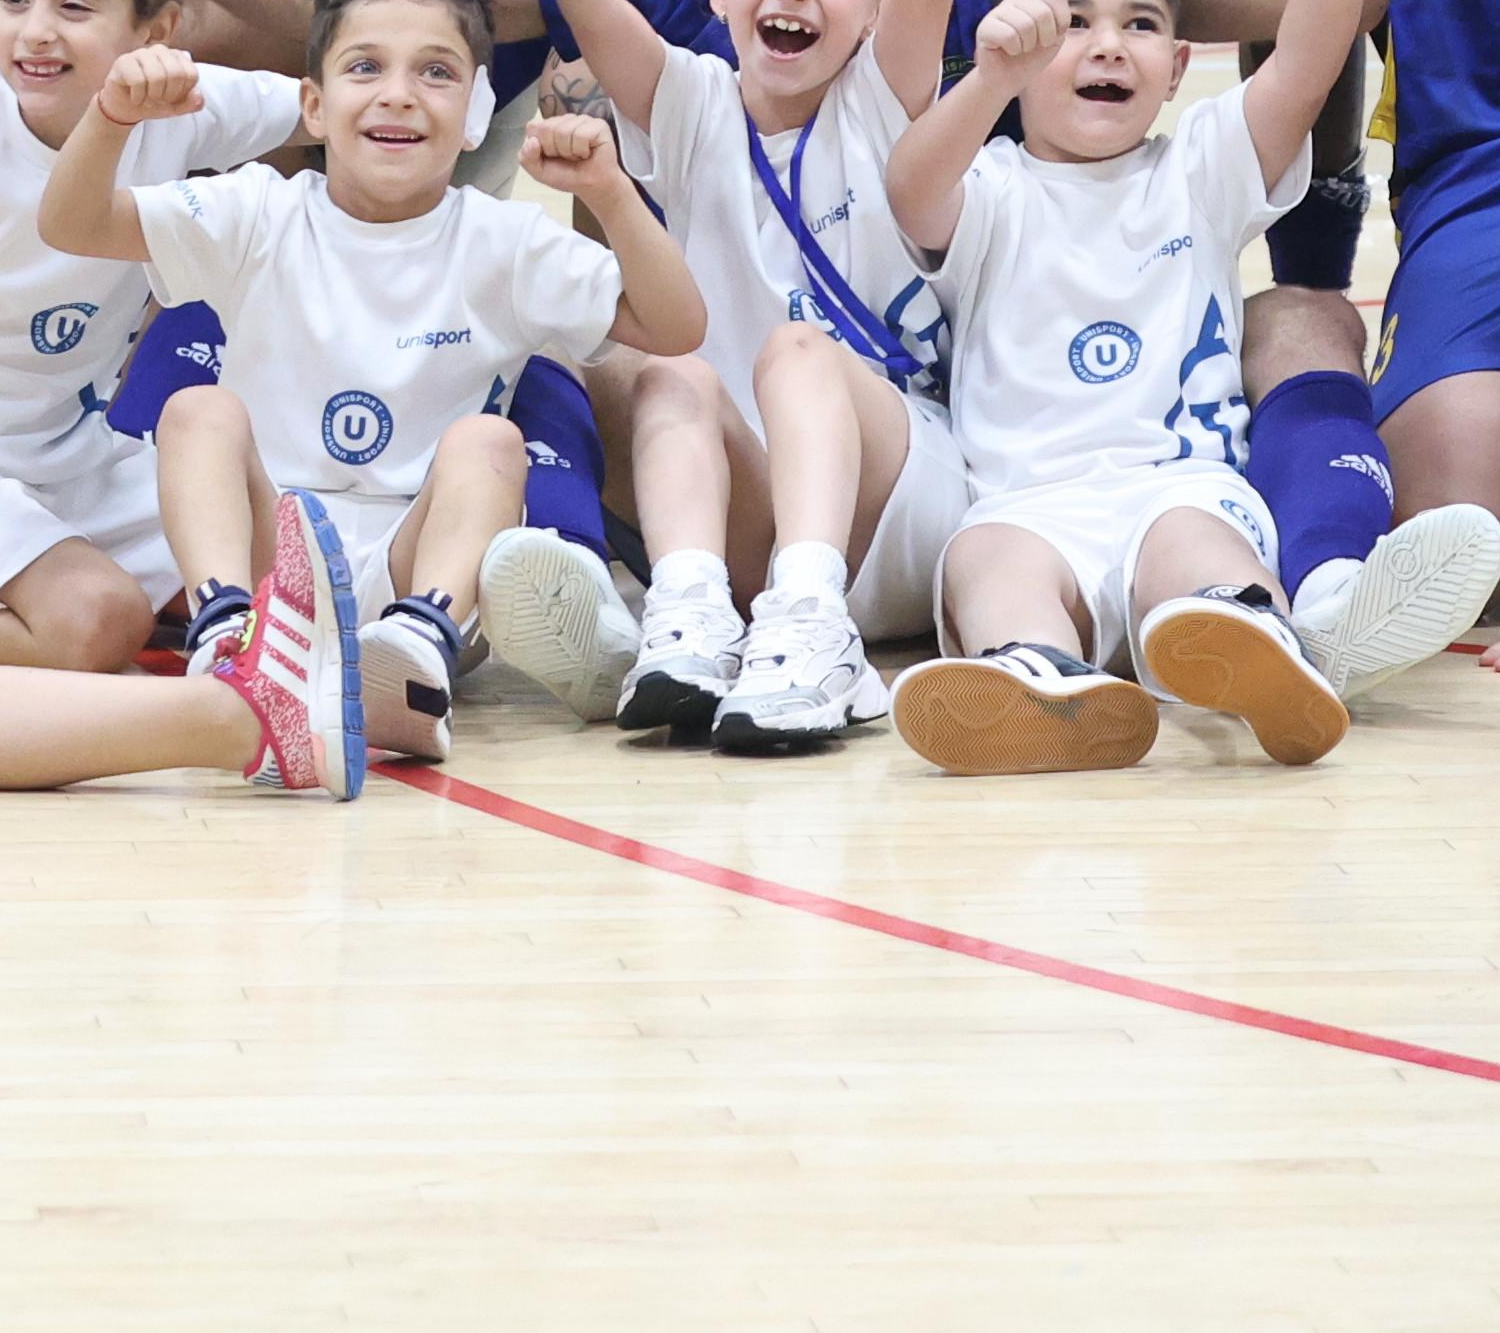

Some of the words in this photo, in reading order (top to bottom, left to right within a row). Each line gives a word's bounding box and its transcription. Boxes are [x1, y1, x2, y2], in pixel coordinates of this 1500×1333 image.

[396, 328, 472, 349] unisport
[1095, 344, 1118, 366] U
[344, 415, 366, 440] U
